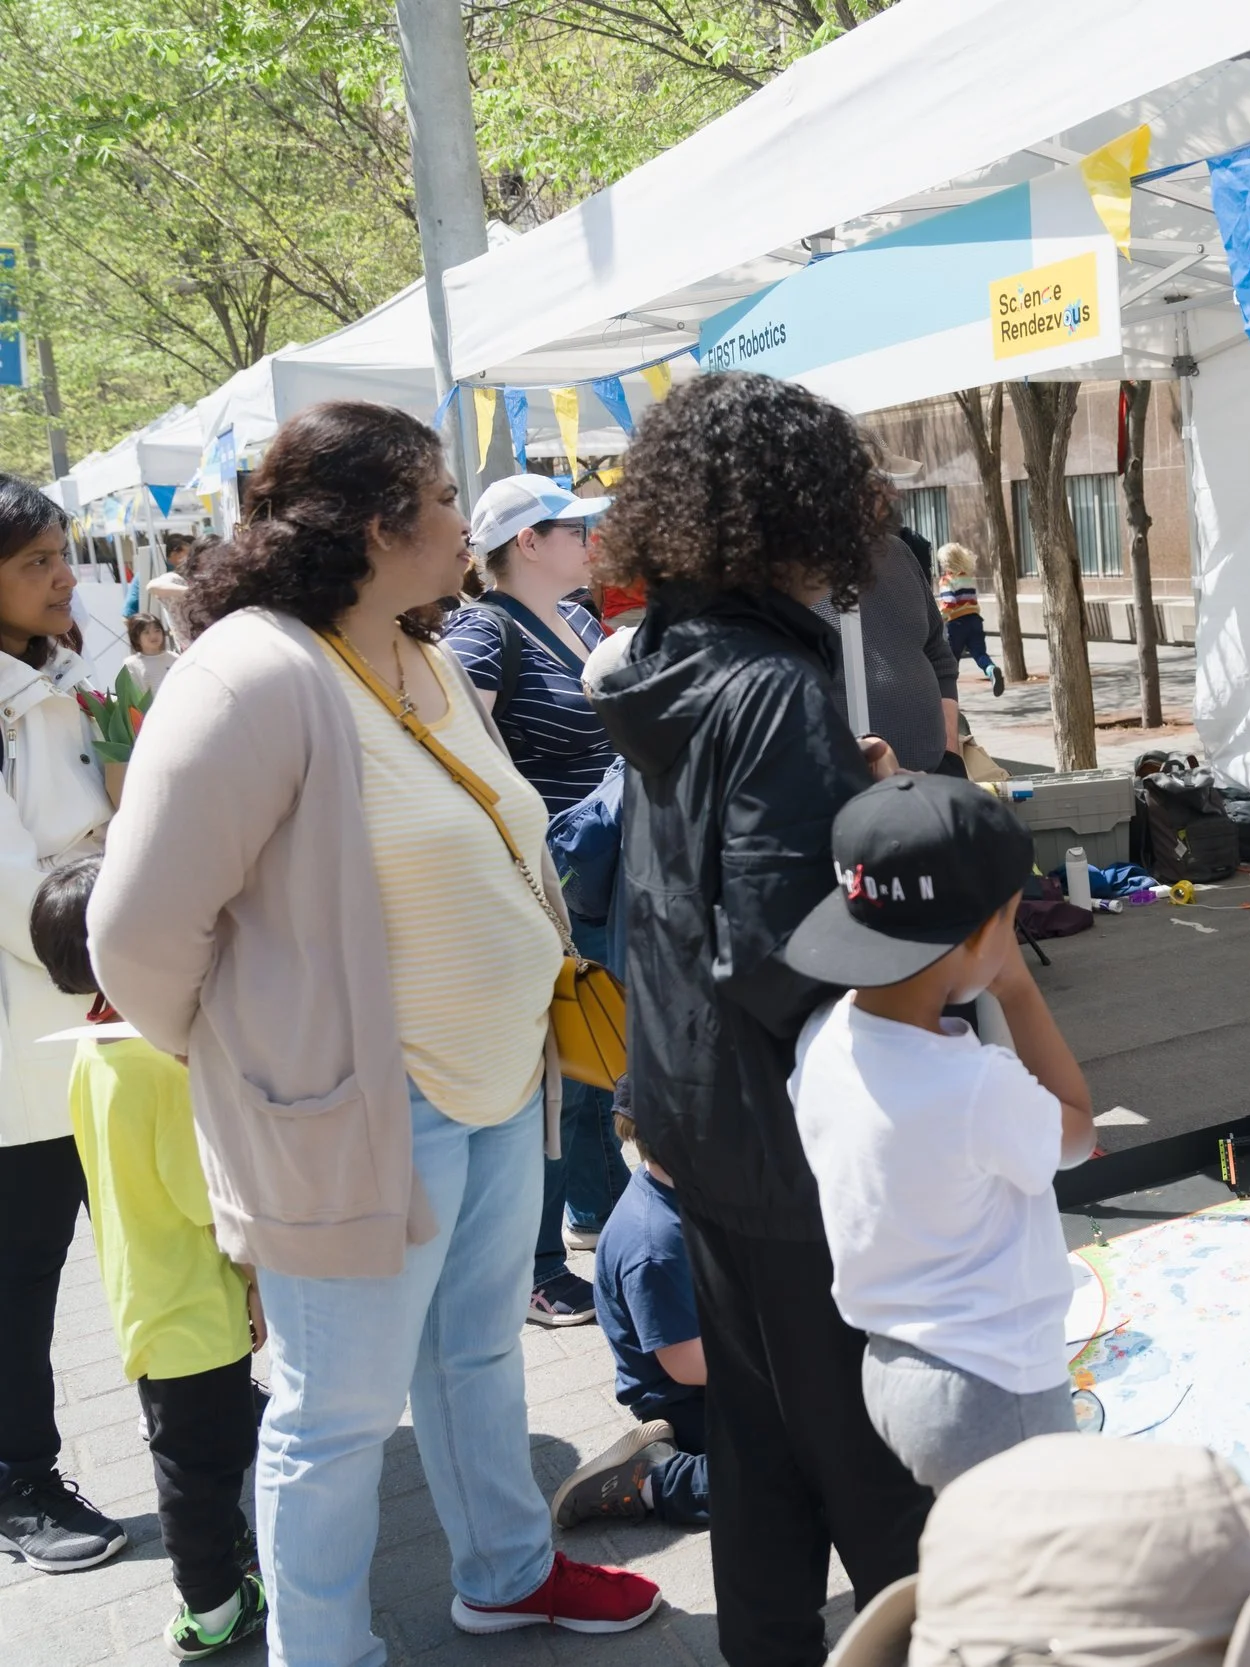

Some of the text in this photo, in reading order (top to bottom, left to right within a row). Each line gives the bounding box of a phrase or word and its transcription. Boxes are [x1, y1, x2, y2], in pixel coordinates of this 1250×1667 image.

[1000, 284, 1062, 316] Science
[1001, 304, 1090, 343] Rendezvous
[707, 321, 786, 376] FIRST Robotics
